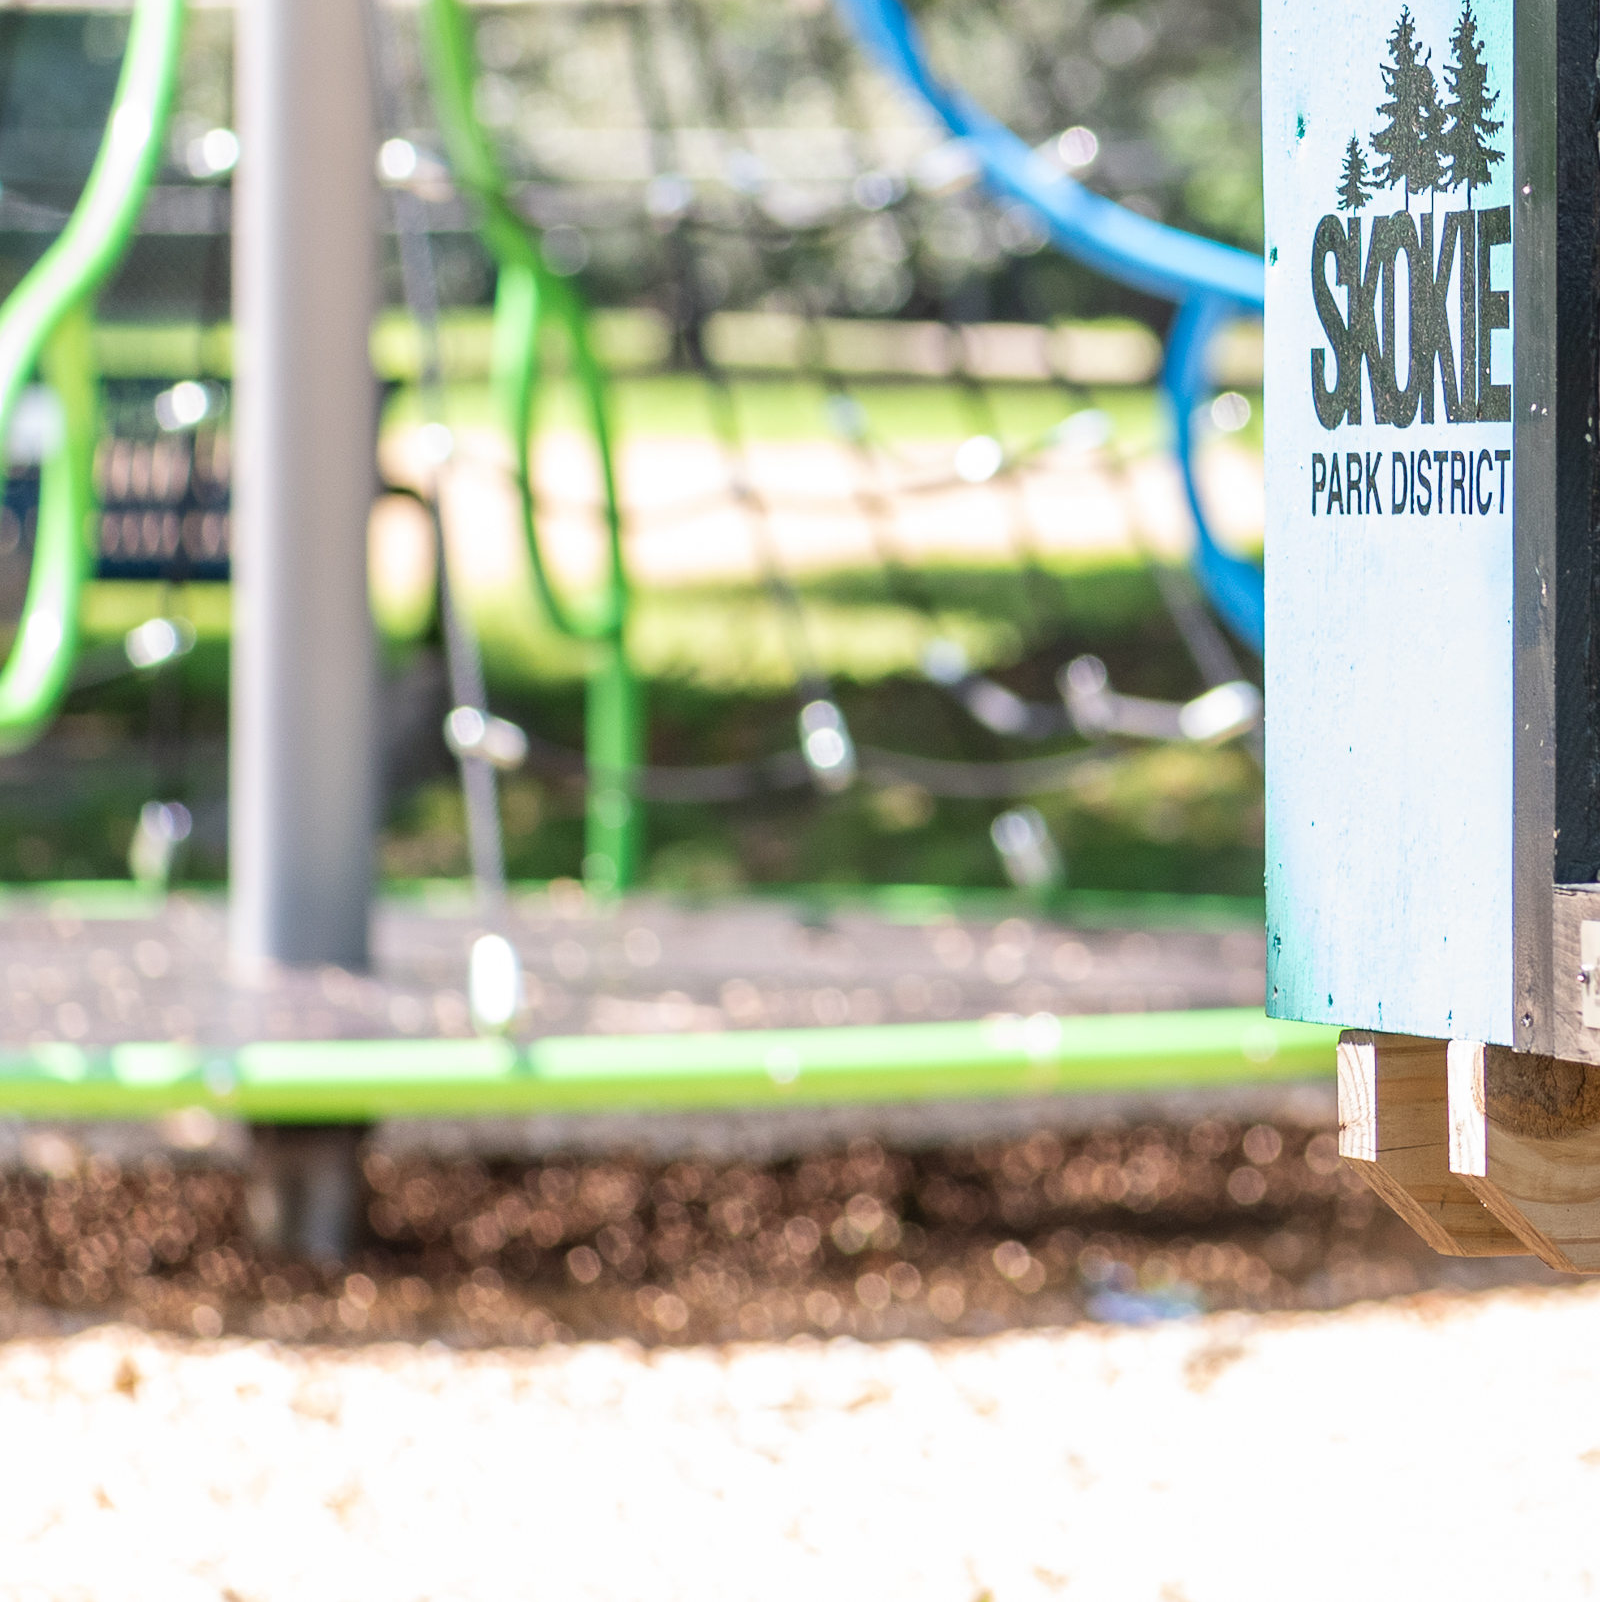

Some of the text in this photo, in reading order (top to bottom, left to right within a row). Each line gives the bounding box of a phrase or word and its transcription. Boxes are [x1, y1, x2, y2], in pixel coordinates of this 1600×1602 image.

[1311, 205, 1512, 429] SKOKIE
[1312, 449, 1511, 516] PARK DISTRICT
